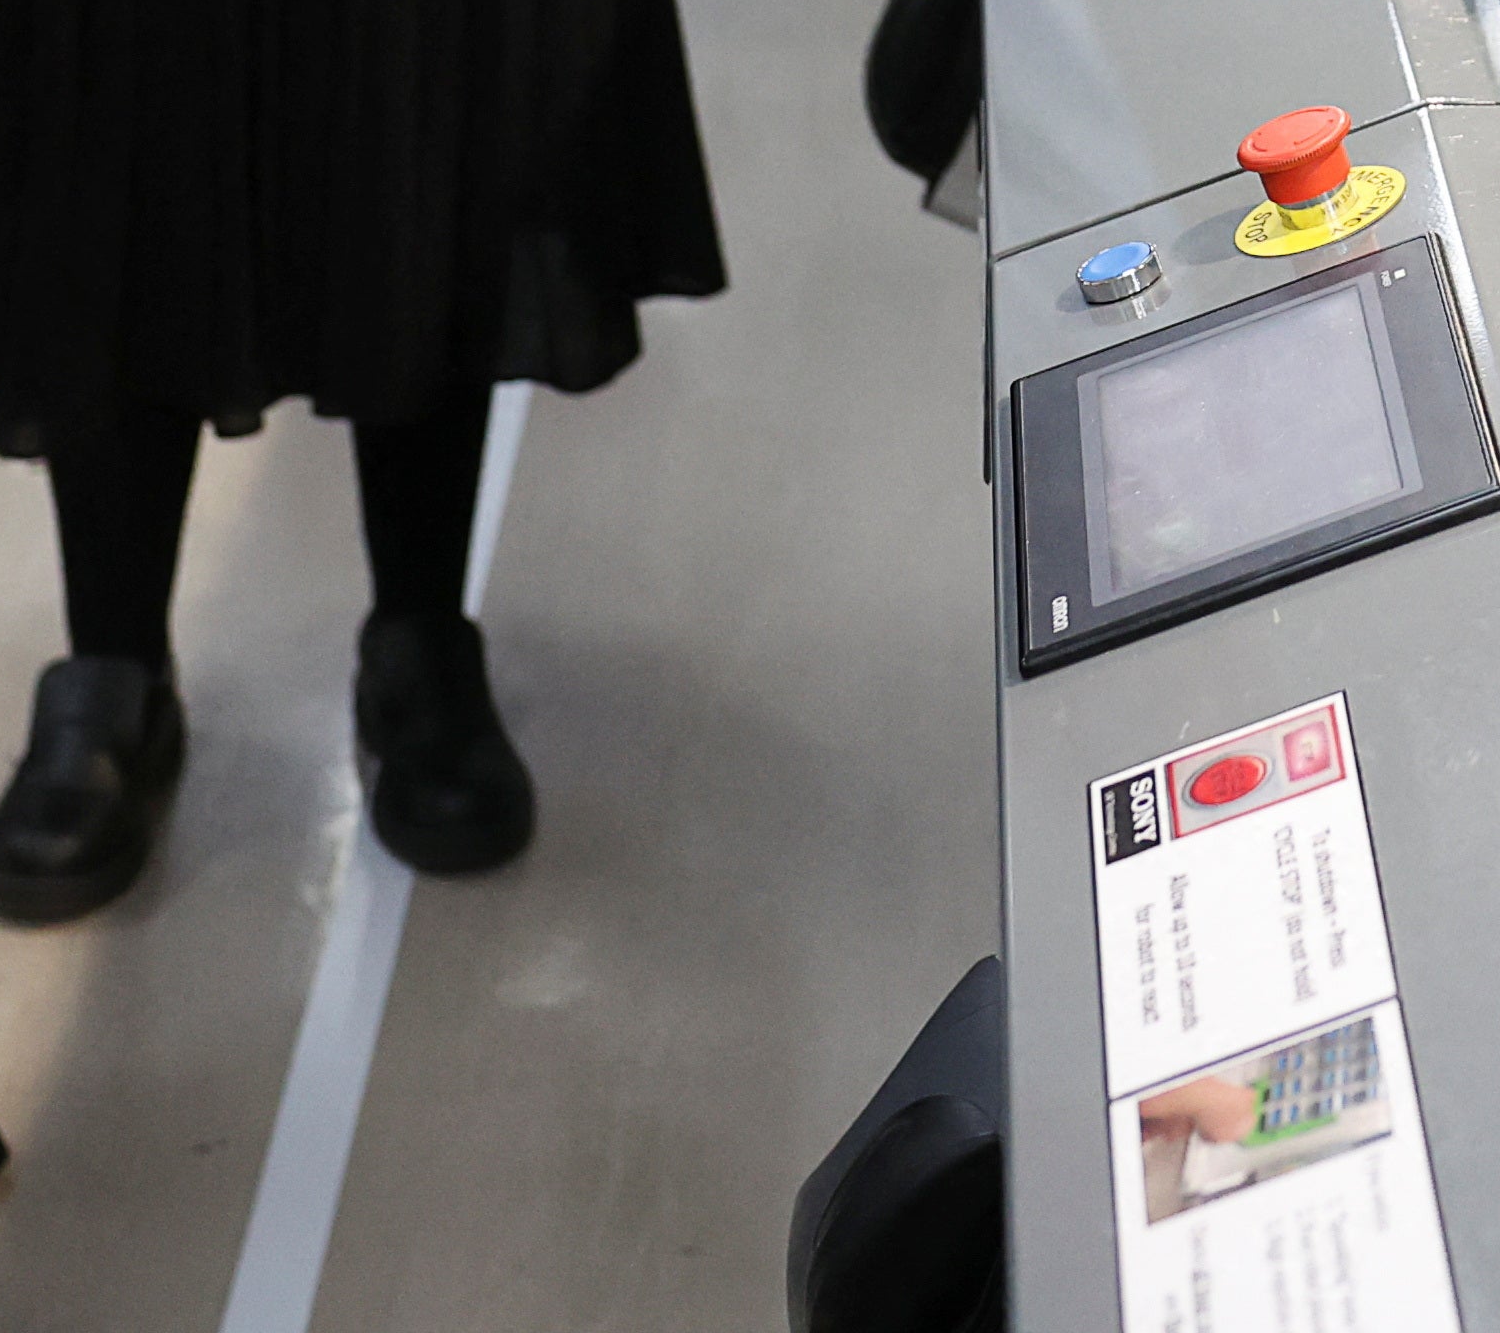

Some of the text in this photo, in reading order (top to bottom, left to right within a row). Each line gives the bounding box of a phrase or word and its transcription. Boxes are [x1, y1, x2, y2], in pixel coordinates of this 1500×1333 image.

[1244, 211, 1273, 244] STOP
[1331, 169, 1396, 237] MERGENCY
[1129, 776, 1157, 845] SONY
